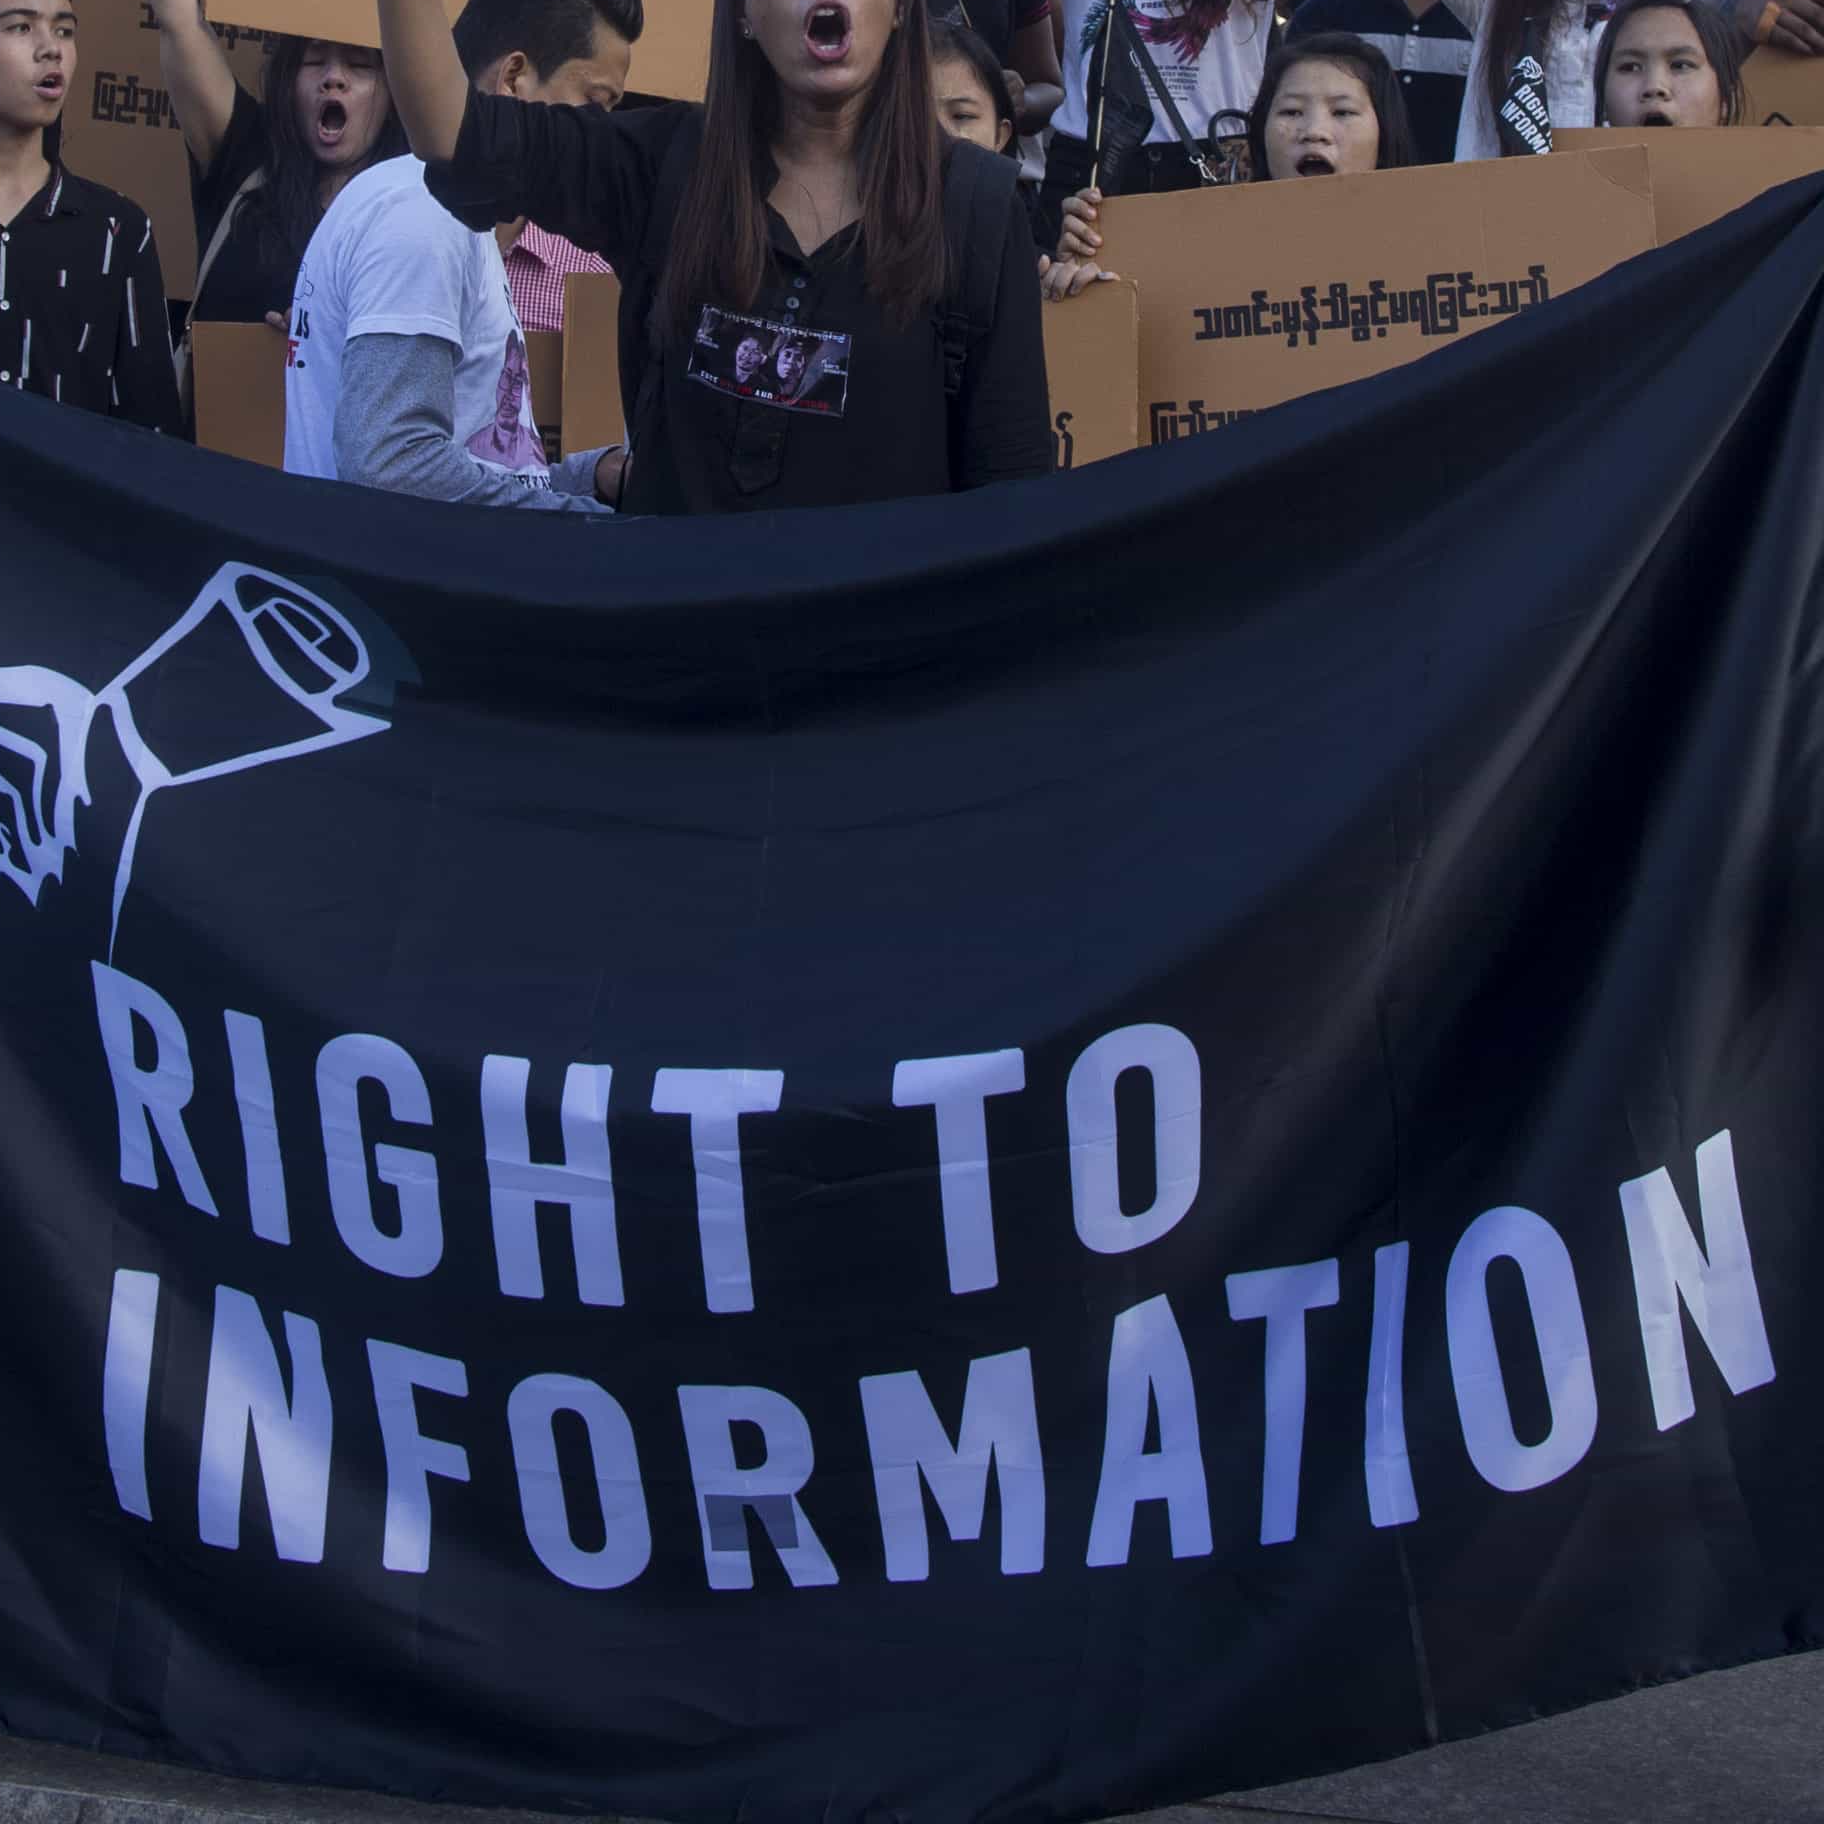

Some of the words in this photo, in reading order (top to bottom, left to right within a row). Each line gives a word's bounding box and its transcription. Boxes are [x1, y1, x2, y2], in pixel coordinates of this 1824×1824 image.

[1514, 83, 1551, 127] RIGHT
[92, 958, 783, 1315] RIGHT
[893, 1022, 1201, 1295] TO
[102, 1127, 1776, 1591] INFORMATION
